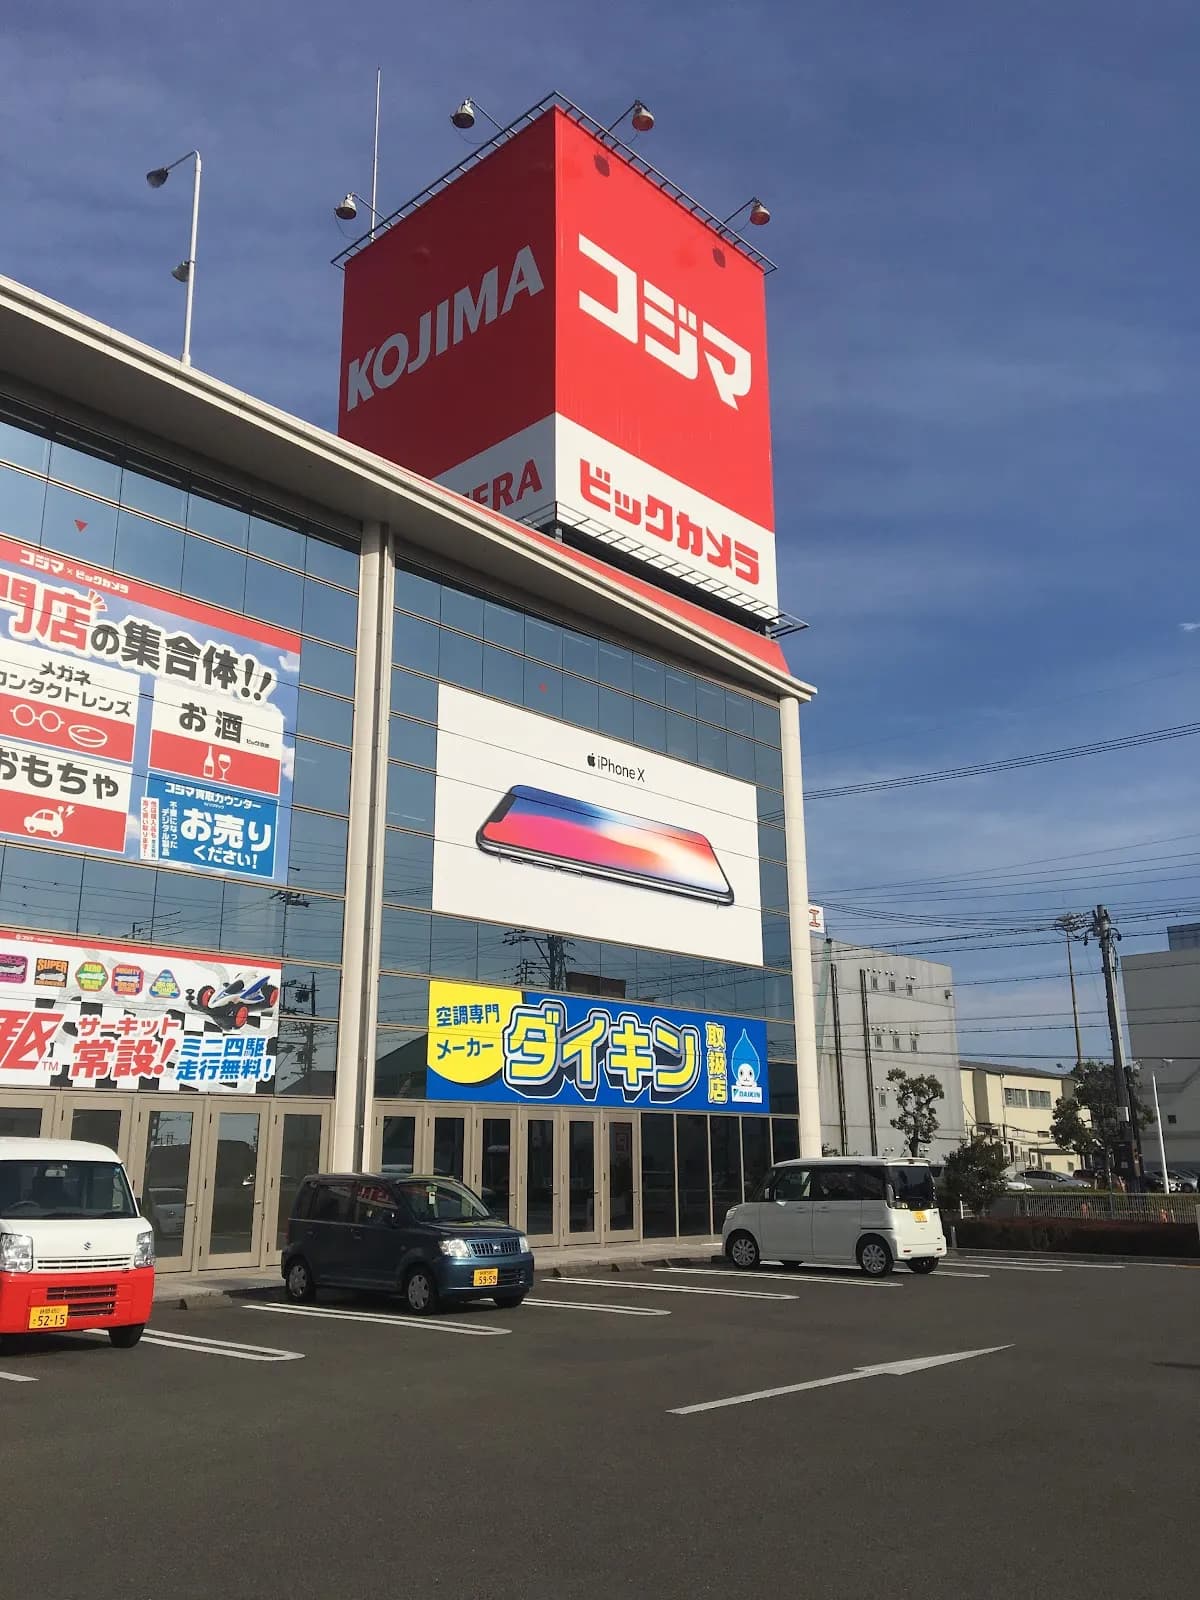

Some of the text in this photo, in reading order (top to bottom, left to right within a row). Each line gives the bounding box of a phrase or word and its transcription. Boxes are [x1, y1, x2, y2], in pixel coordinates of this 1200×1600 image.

[347, 244, 545, 412] KOJIMA
[579, 233, 752, 411] コジマ
[463, 459, 543, 510] ERA
[579, 458, 759, 585] ビックカメラ
[20, 550, 65, 574] コジマ
[39, 661, 91, 685] メガネ
[180, 702, 243, 744] お酒
[597, 755, 645, 783] iPhone X
[181, 808, 272, 853] お売り
[193, 844, 258, 870] ください!
[37, 959, 67, 974] SUPER
[79, 1017, 179, 1036] サーキット
[436, 1003, 500, 1027] 空調専門
[71, 1038, 176, 1078] 常設!
[181, 1037, 266, 1058] ミニ四駆
[436, 1037, 494, 1060] メーカー
[506, 1006, 698, 1090] ダイキン
[175, 1059, 272, 1081] 走行無料!
[707, 1022, 727, 1103] 取扱店
[37, 1314, 65, 1327] 52-15
